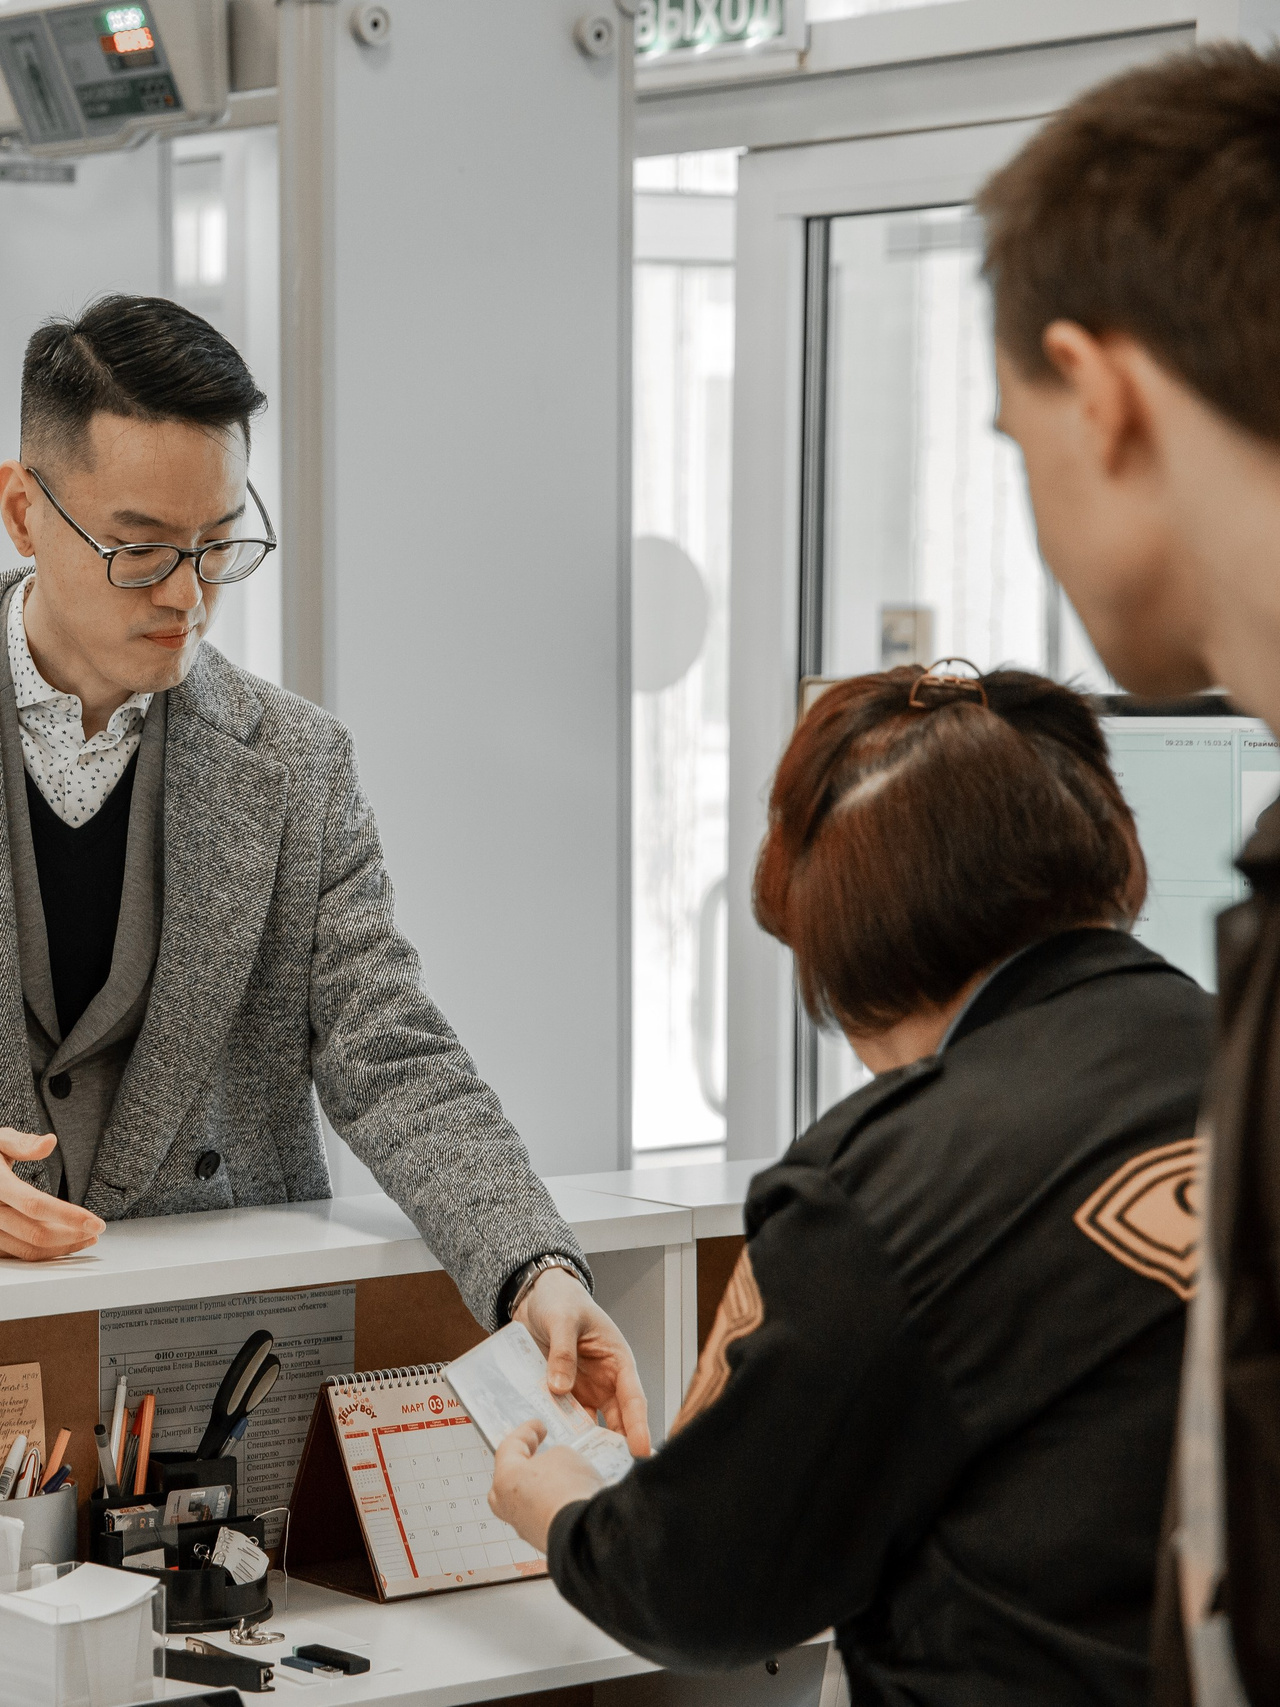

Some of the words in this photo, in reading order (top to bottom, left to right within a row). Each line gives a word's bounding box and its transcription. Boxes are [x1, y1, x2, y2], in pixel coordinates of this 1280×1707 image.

[1203, 739, 1232, 748] 15.03.24
[101, 1308, 142, 1320] Сотрудники
[145, 1303, 197, 1315] администрации
[199, 1301, 226, 1311] Группы
[228, 1296, 257, 1307] «СТАРК
[310, 1289, 341, 1300] имеющие
[100, 1321, 148, 1331] осуществлять
[150, 1316, 178, 1326] гласные
[186, 1312, 221, 1322] негласные
[223, 1309, 254, 1320] проверки
[256, 1305, 296, 1317] охраняемых
[298, 1301, 328, 1312] объектов:
[303, 1335, 342, 1347] сотрудника
[154, 1351, 174, 1361] ФИО
[176, 1347, 218, 1360] сотрудника
[295, 1349, 319, 1360] группы
[173, 1360, 197, 1370] Елена
[199, 1357, 237, 1368] Васильевн
[291, 1359, 320, 1370] контроля
[286, 1370, 323, 1382] Президента
[156, 1384, 187, 1395] Алексей
[288, 1393, 296, 1402] по
[156, 1405, 186, 1416] Николай
[249, 1406, 280, 1416] онтролю
[401, 1402, 425, 1414] МАРТ
[429, 1398, 443, 1411] 03
[338, 1403, 358, 1425] JELLY
[360, 1404, 377, 1419] BOY
[248, 1416, 286, 1428] Специалист
[288, 1415, 296, 1423] по
[160, 1427, 192, 1439] Дмитрий
[247, 1428, 280, 1439] контролю
[247, 1438, 286, 1450] Специалист
[247, 1450, 280, 1461] контролю
[436, 1455, 441, 1463] 6
[247, 1460, 285, 1472] Специалист
[287, 1459, 295, 1467] по
[246, 1472, 279, 1483] контролю
[246, 1482, 284, 1494] Специалист
[246, 1494, 279, 1505] контролю
[401, 1508, 408, 1516] 18
[408, 1532, 416, 1540] 25
[455, 1525, 463, 1533] 27
[479, 1522, 487, 1530] 28
